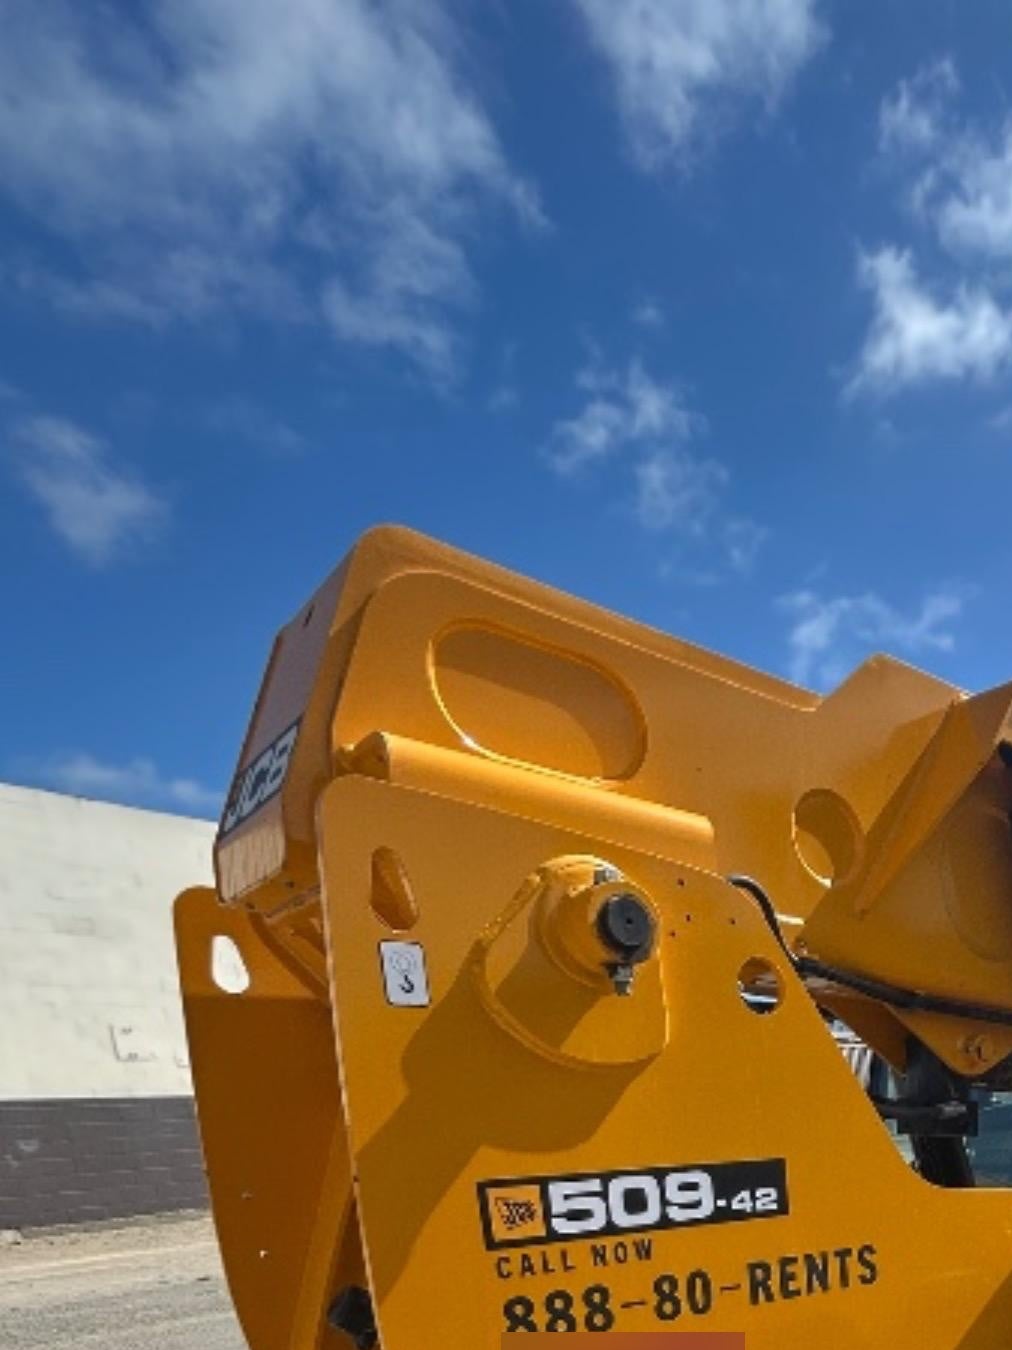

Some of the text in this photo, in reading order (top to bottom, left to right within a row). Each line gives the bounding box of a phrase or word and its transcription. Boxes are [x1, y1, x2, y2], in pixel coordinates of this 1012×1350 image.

[547, 1169, 778, 1234] 509-42
[496, 1238, 654, 1279] CALL NOW
[502, 1244, 878, 1333] 888-80-RENTS
